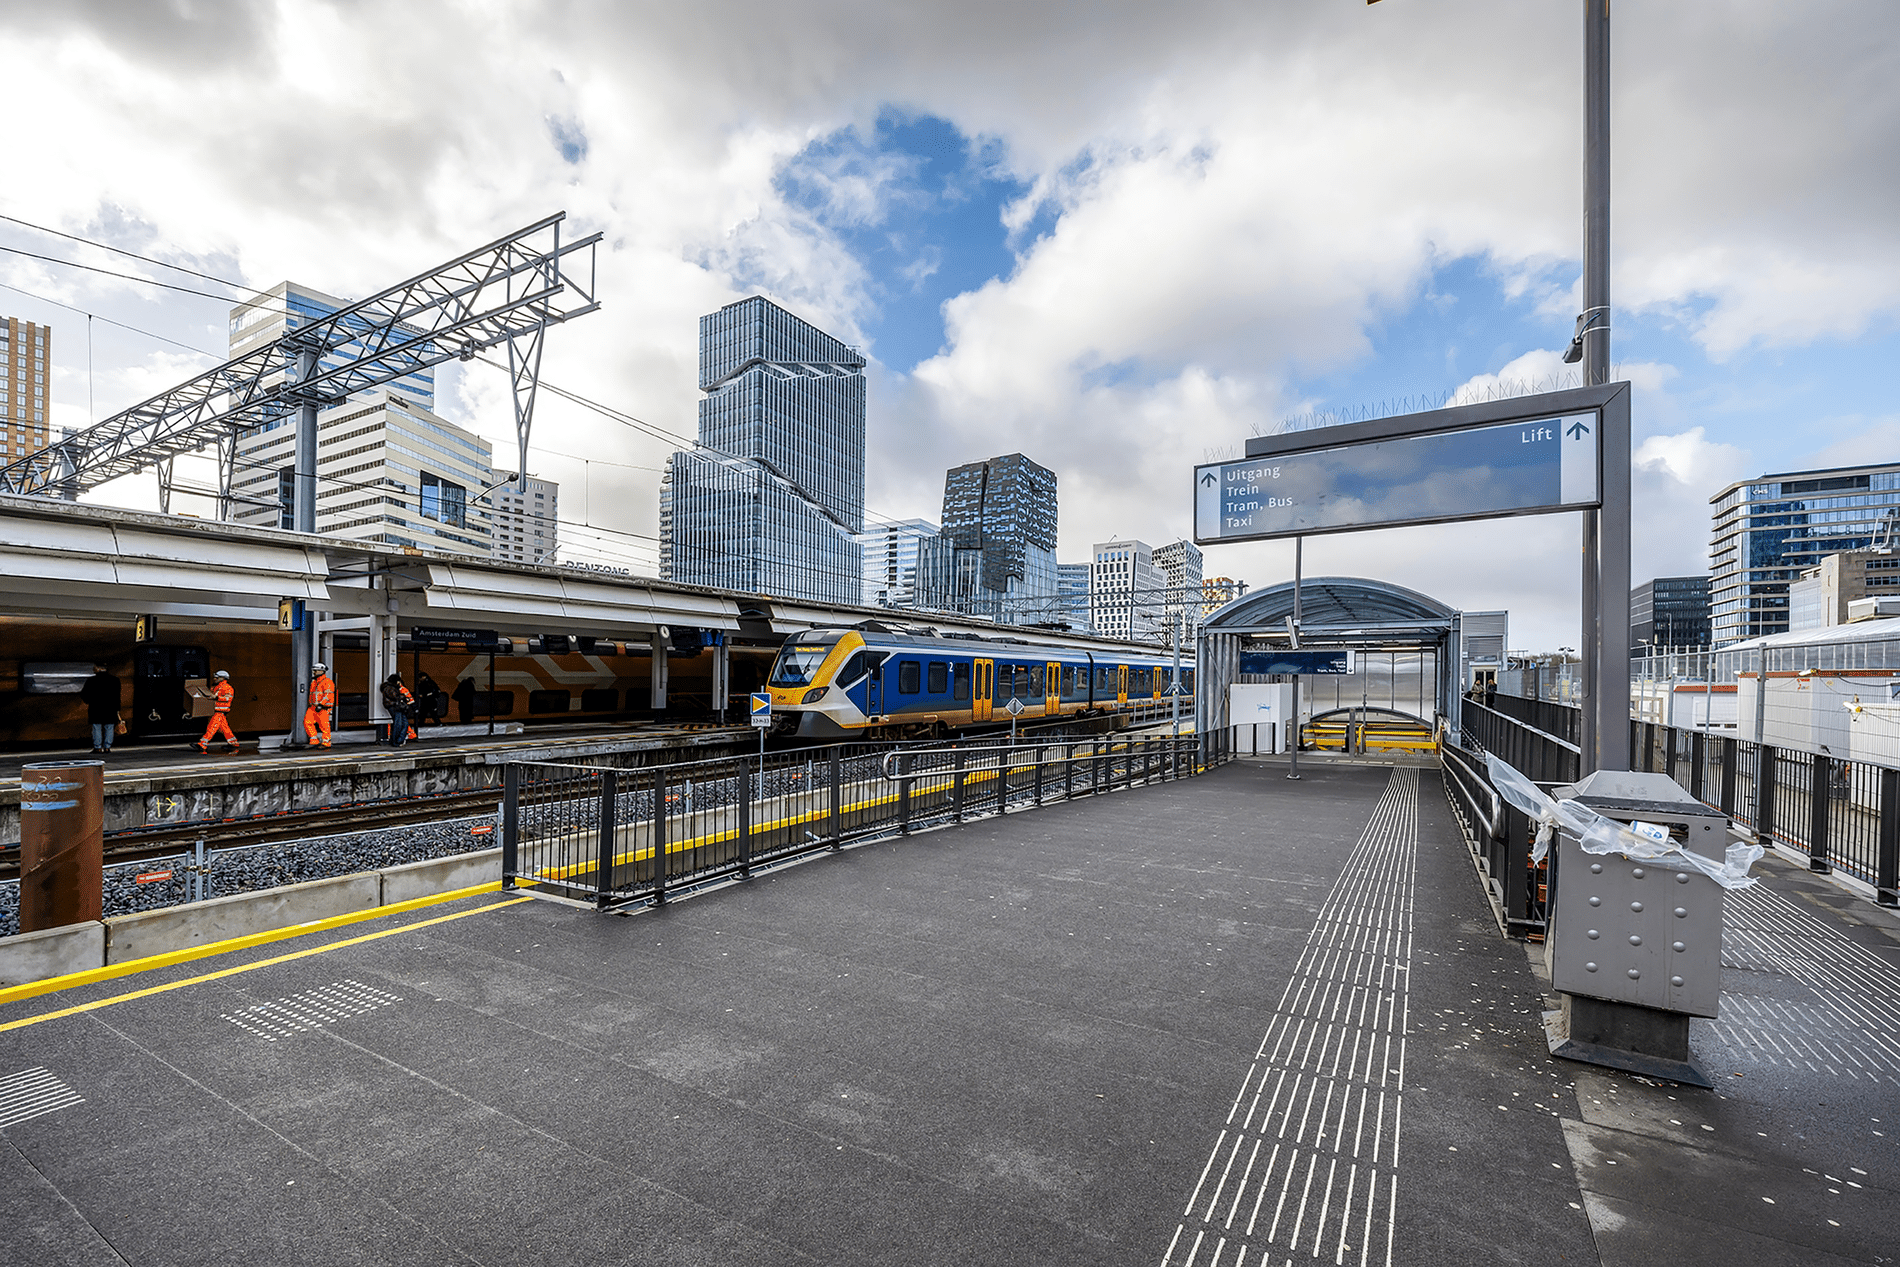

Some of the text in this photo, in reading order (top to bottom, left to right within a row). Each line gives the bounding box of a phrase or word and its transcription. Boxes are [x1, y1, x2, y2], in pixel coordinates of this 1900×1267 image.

[1521, 427, 1553, 443] Lift
[1227, 466, 1281, 482] Uitgang
[1226, 484, 1259, 497] Trein
[1226, 497, 1293, 512] Tram, Bus
[1226, 514, 1252, 528] Taxi
[282, 610, 289, 627] 4
[419, 630, 477, 639] Amsterdam Zuid
[948, 661, 954, 672] 2
